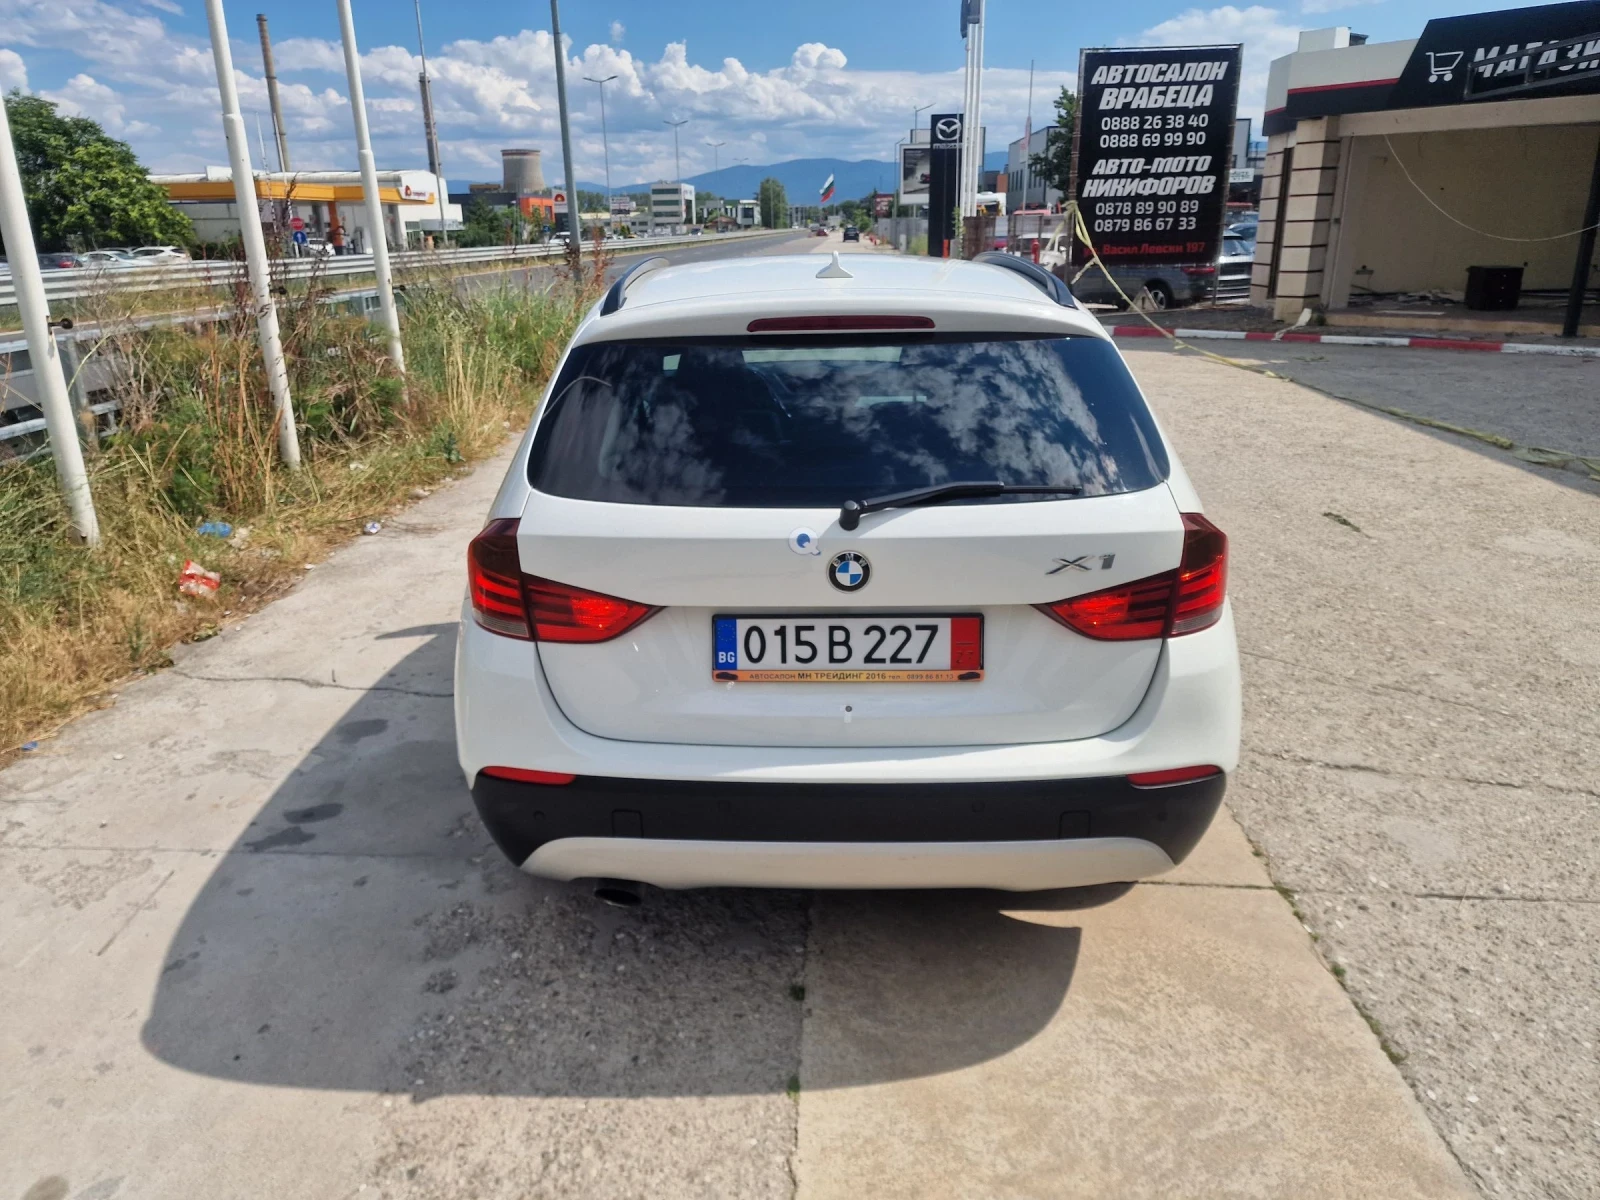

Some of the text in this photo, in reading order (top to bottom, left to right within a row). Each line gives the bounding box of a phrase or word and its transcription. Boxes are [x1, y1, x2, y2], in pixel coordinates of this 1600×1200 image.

[1091, 61, 1229, 85] АВТОСАЛОН
[1098, 84, 1214, 110] ВРАБЕЦА
[1101, 113, 1209, 130] 0888 26 38 40
[1099, 131, 1206, 148] 0888 69 99 90
[1091, 155, 1212, 175] АВТО-МОТО
[1082, 175, 1217, 198] НИКИФОРОВ
[1095, 200, 1199, 216] 0878 89 90 89
[1094, 217, 1197, 232] 0879 86 67 33
[1103, 243, 1138, 255] Васил
[1140, 243, 1184, 254] Левски
[1186, 241, 1205, 253] 197
[1045, 554, 1115, 575] X1
[743, 625, 818, 664] 015
[863, 625, 939, 664] 227
[718, 651, 735, 664] BG
[797, 672, 811, 680] МН
[814, 671, 863, 681] ТРЕЙДИНГ
[866, 672, 886, 680] 2016
